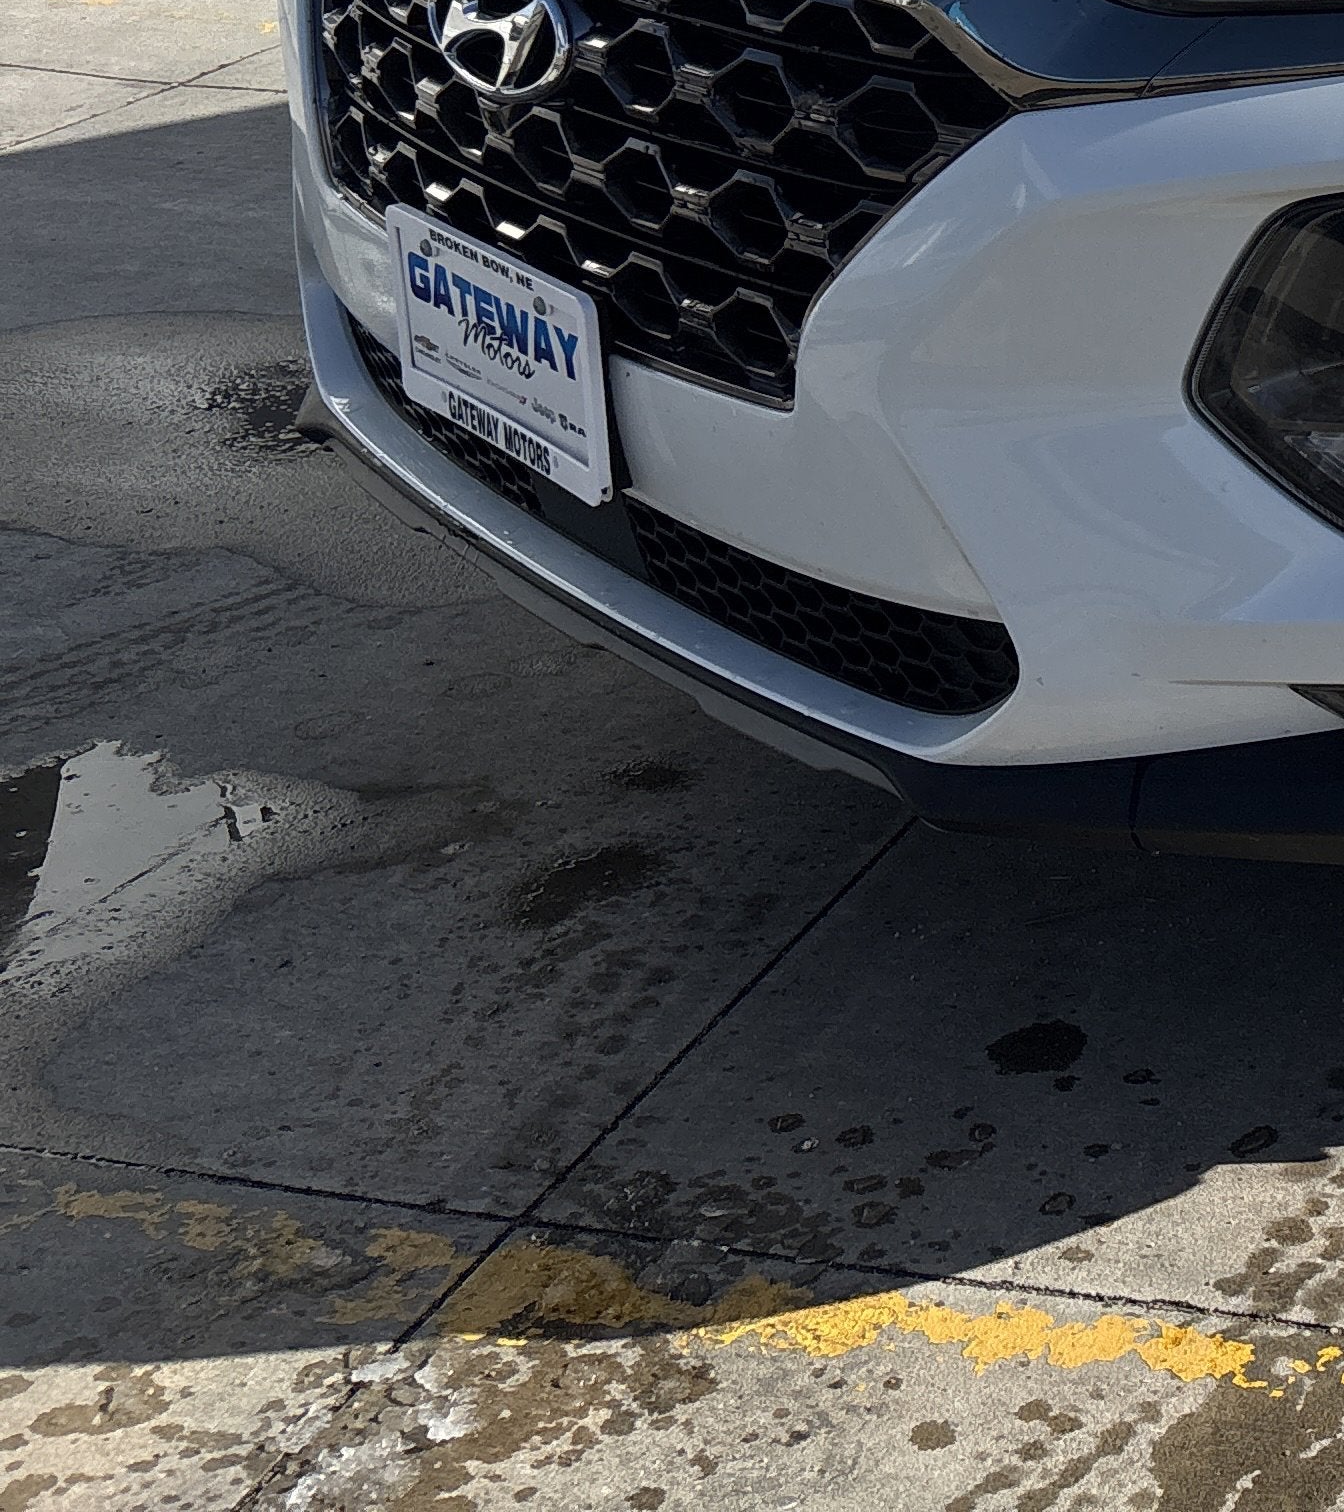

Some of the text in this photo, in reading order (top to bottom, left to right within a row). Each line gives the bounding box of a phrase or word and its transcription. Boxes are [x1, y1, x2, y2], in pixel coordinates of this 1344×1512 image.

[429, 229, 479, 265] BROKEN
[516, 274, 535, 292] NE
[407, 251, 579, 381] GATEWAY
[458, 318, 536, 380] Motors
[449, 390, 500, 445] GATEWAY
[503, 424, 551, 476] MOTORS
